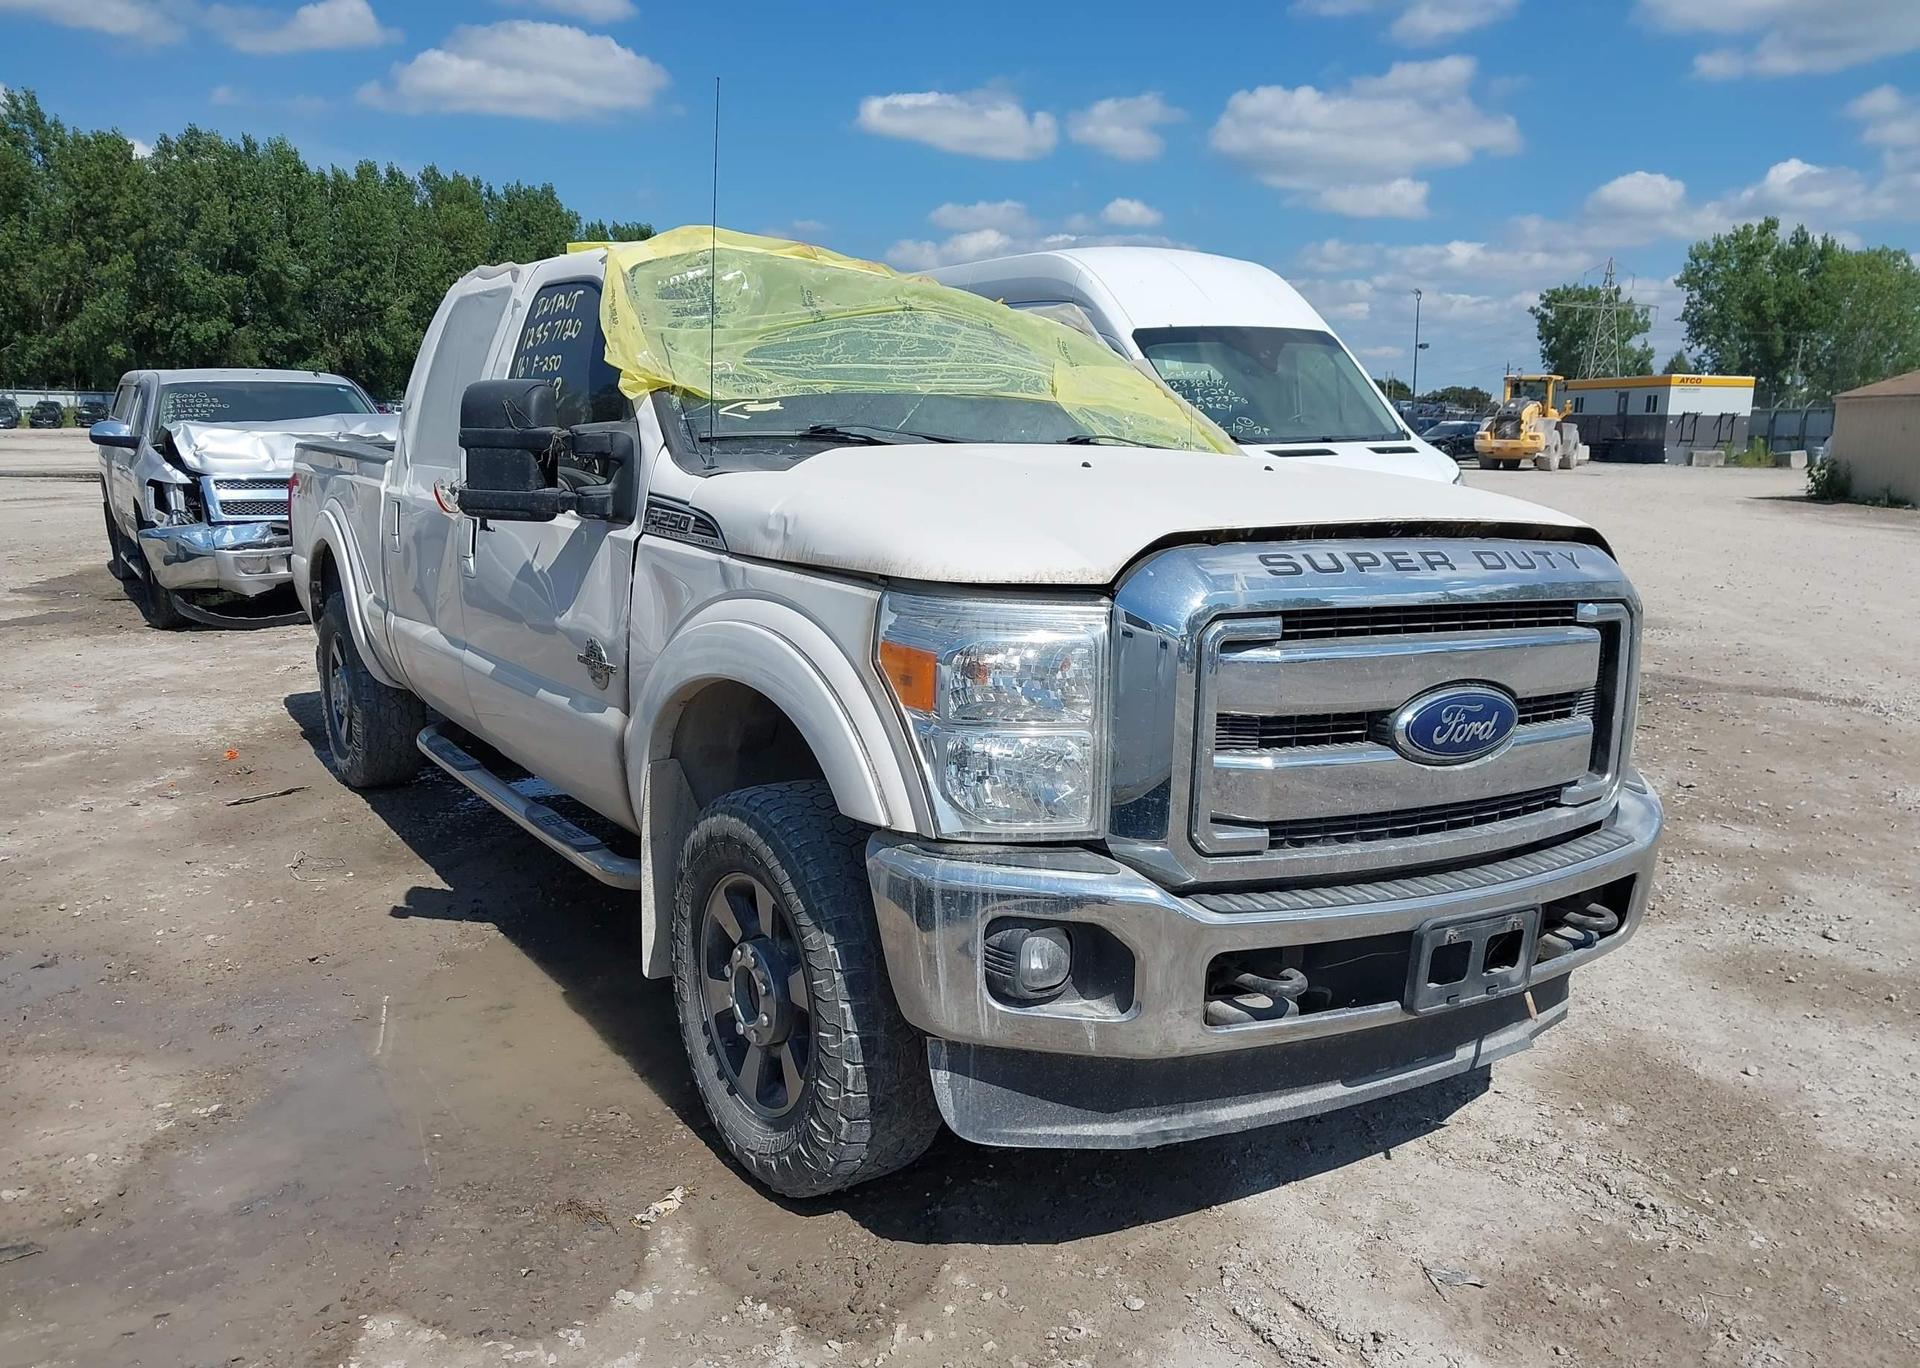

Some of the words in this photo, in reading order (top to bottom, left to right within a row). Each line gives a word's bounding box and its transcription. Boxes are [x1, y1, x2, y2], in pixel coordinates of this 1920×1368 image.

[534, 289, 585, 319] INTACT
[531, 354, 562, 376] F-250
[1679, 376, 1702, 384] ATCO
[645, 507, 696, 533] F-250
[1259, 550, 1457, 576] SUPER
[1472, 550, 1582, 571] DUTY
[1432, 703, 1499, 745] Ford
